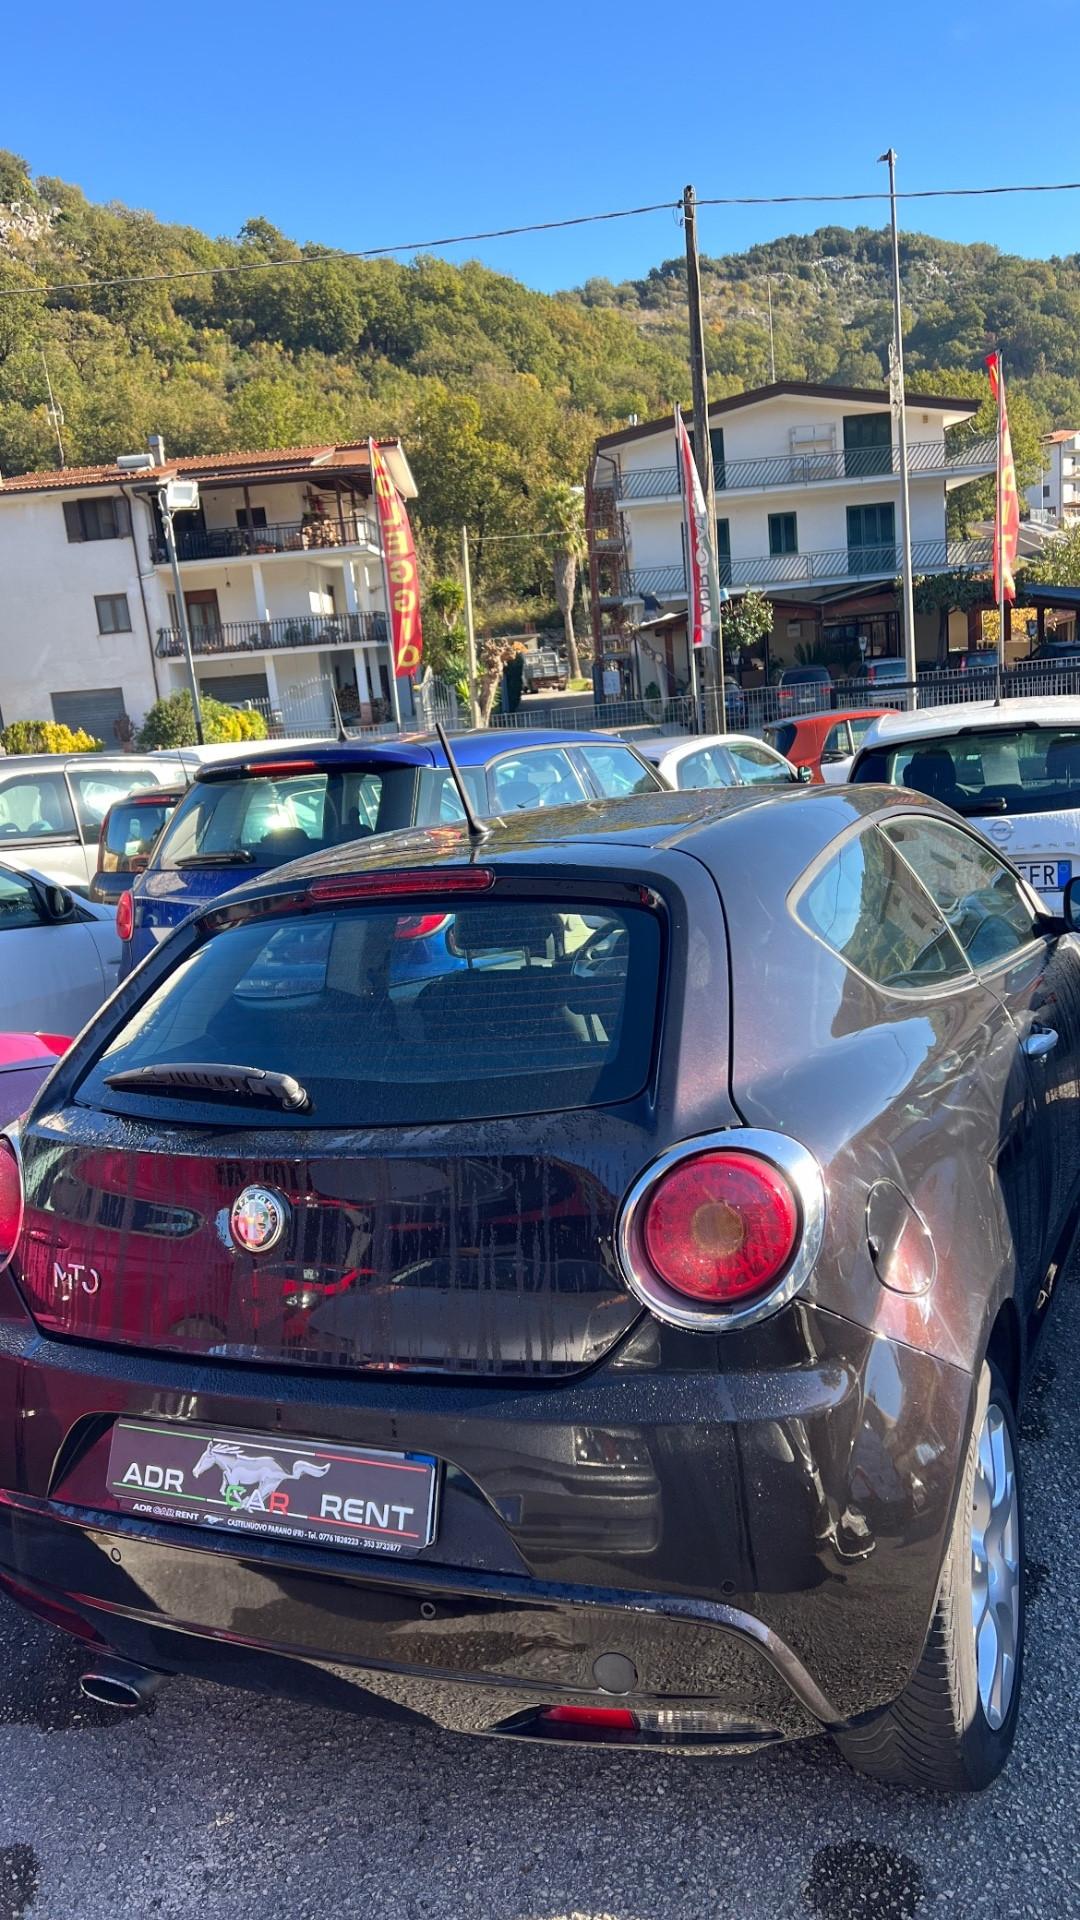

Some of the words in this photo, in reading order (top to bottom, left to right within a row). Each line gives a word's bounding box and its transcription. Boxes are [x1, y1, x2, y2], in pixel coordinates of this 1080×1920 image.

[122, 1462, 184, 1493] ADR
[226, 1484, 290, 1515] CAR
[320, 1494, 414, 1531] RENT
[132, 1503, 153, 1514] ADR
[175, 1510, 199, 1521] RENT
[227, 1518, 268, 1532] CASTELNUOVO
[267, 1523, 292, 1536] PARANO
[307, 1532, 318, 1541] Tel.
